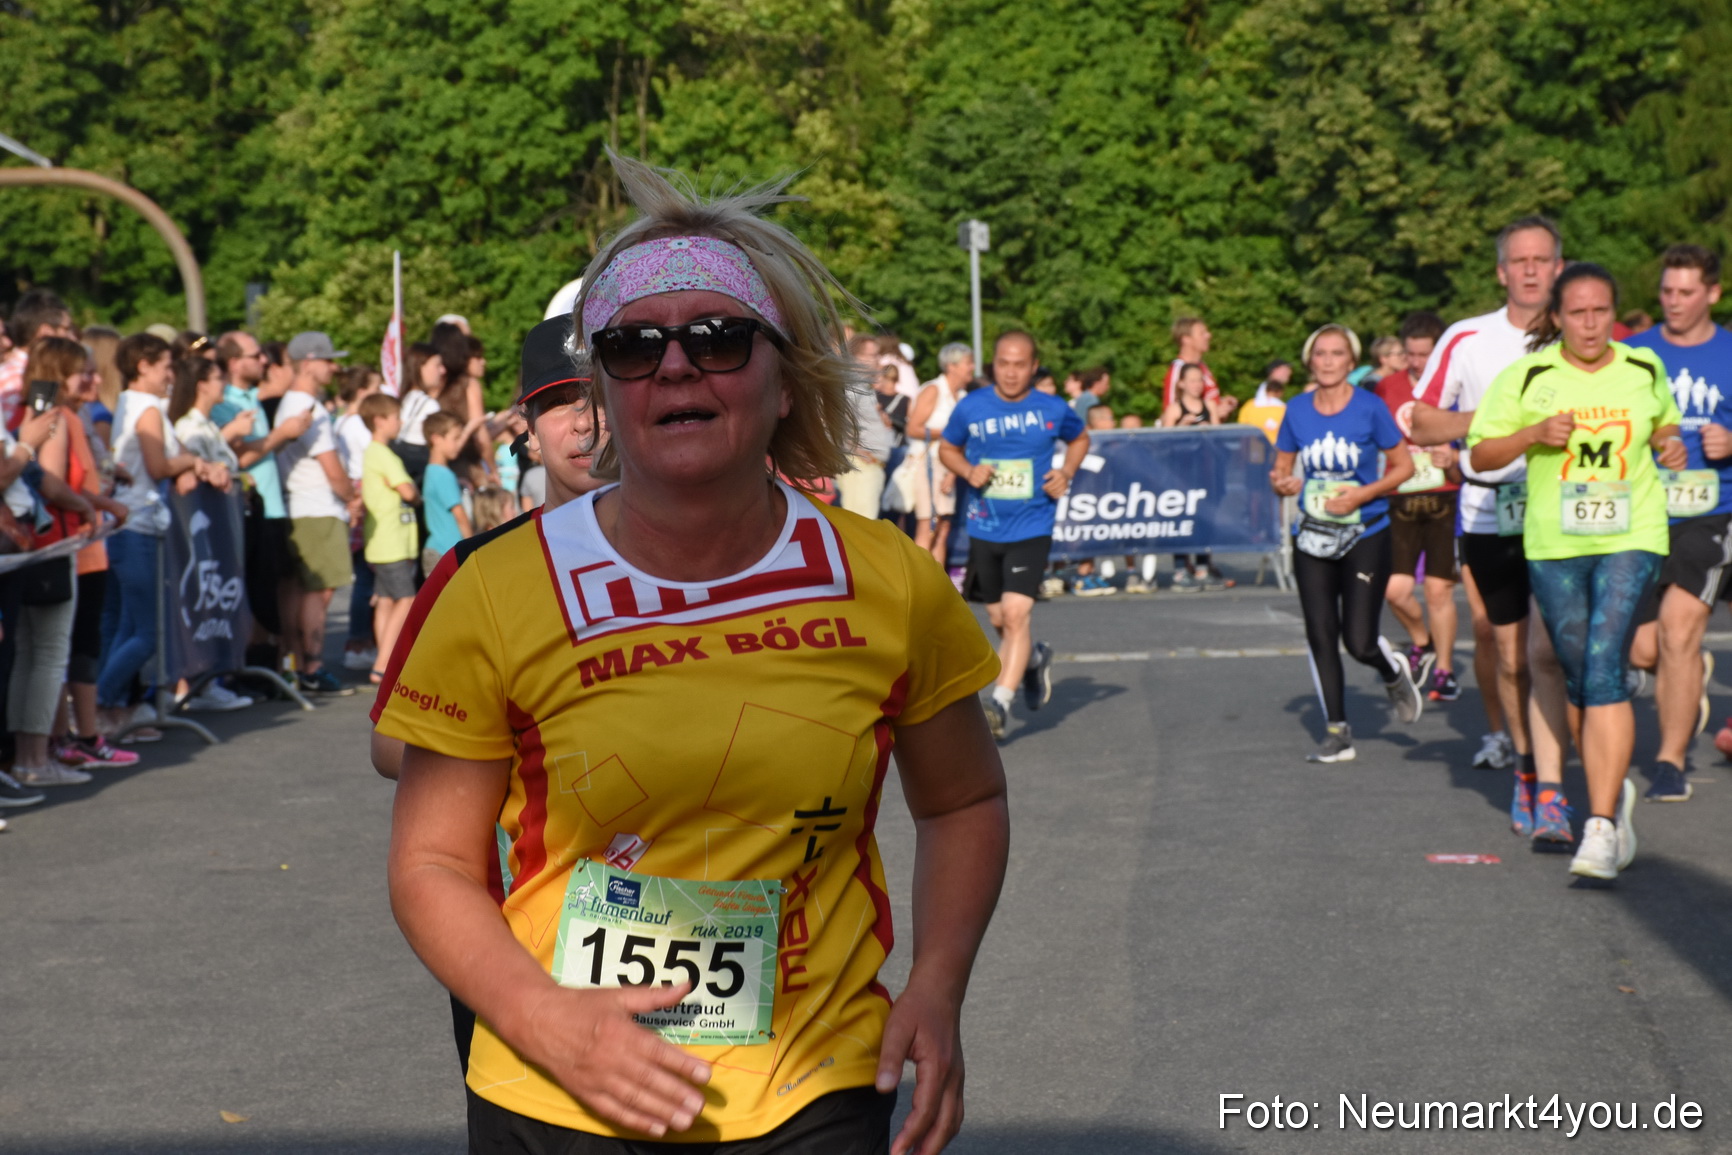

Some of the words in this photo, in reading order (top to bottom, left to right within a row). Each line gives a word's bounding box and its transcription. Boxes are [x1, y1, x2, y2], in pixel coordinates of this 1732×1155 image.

[1559, 404, 1630, 420] üller
[1577, 441, 1613, 469] M
[1055, 482, 1208, 522] ischer
[1574, 500, 1617, 521] 673
[1052, 519, 1195, 542] AUTOMOBILE
[576, 636, 710, 689] MAX
[724, 617, 867, 655] BÖGL
[590, 896, 673, 926] firmenlauf
[690, 925, 718, 938] run
[724, 925, 764, 938] 2019
[582, 927, 745, 998] 1555
[631, 1012, 696, 1028] Bauservice
[699, 1018, 735, 1028] GmbH
